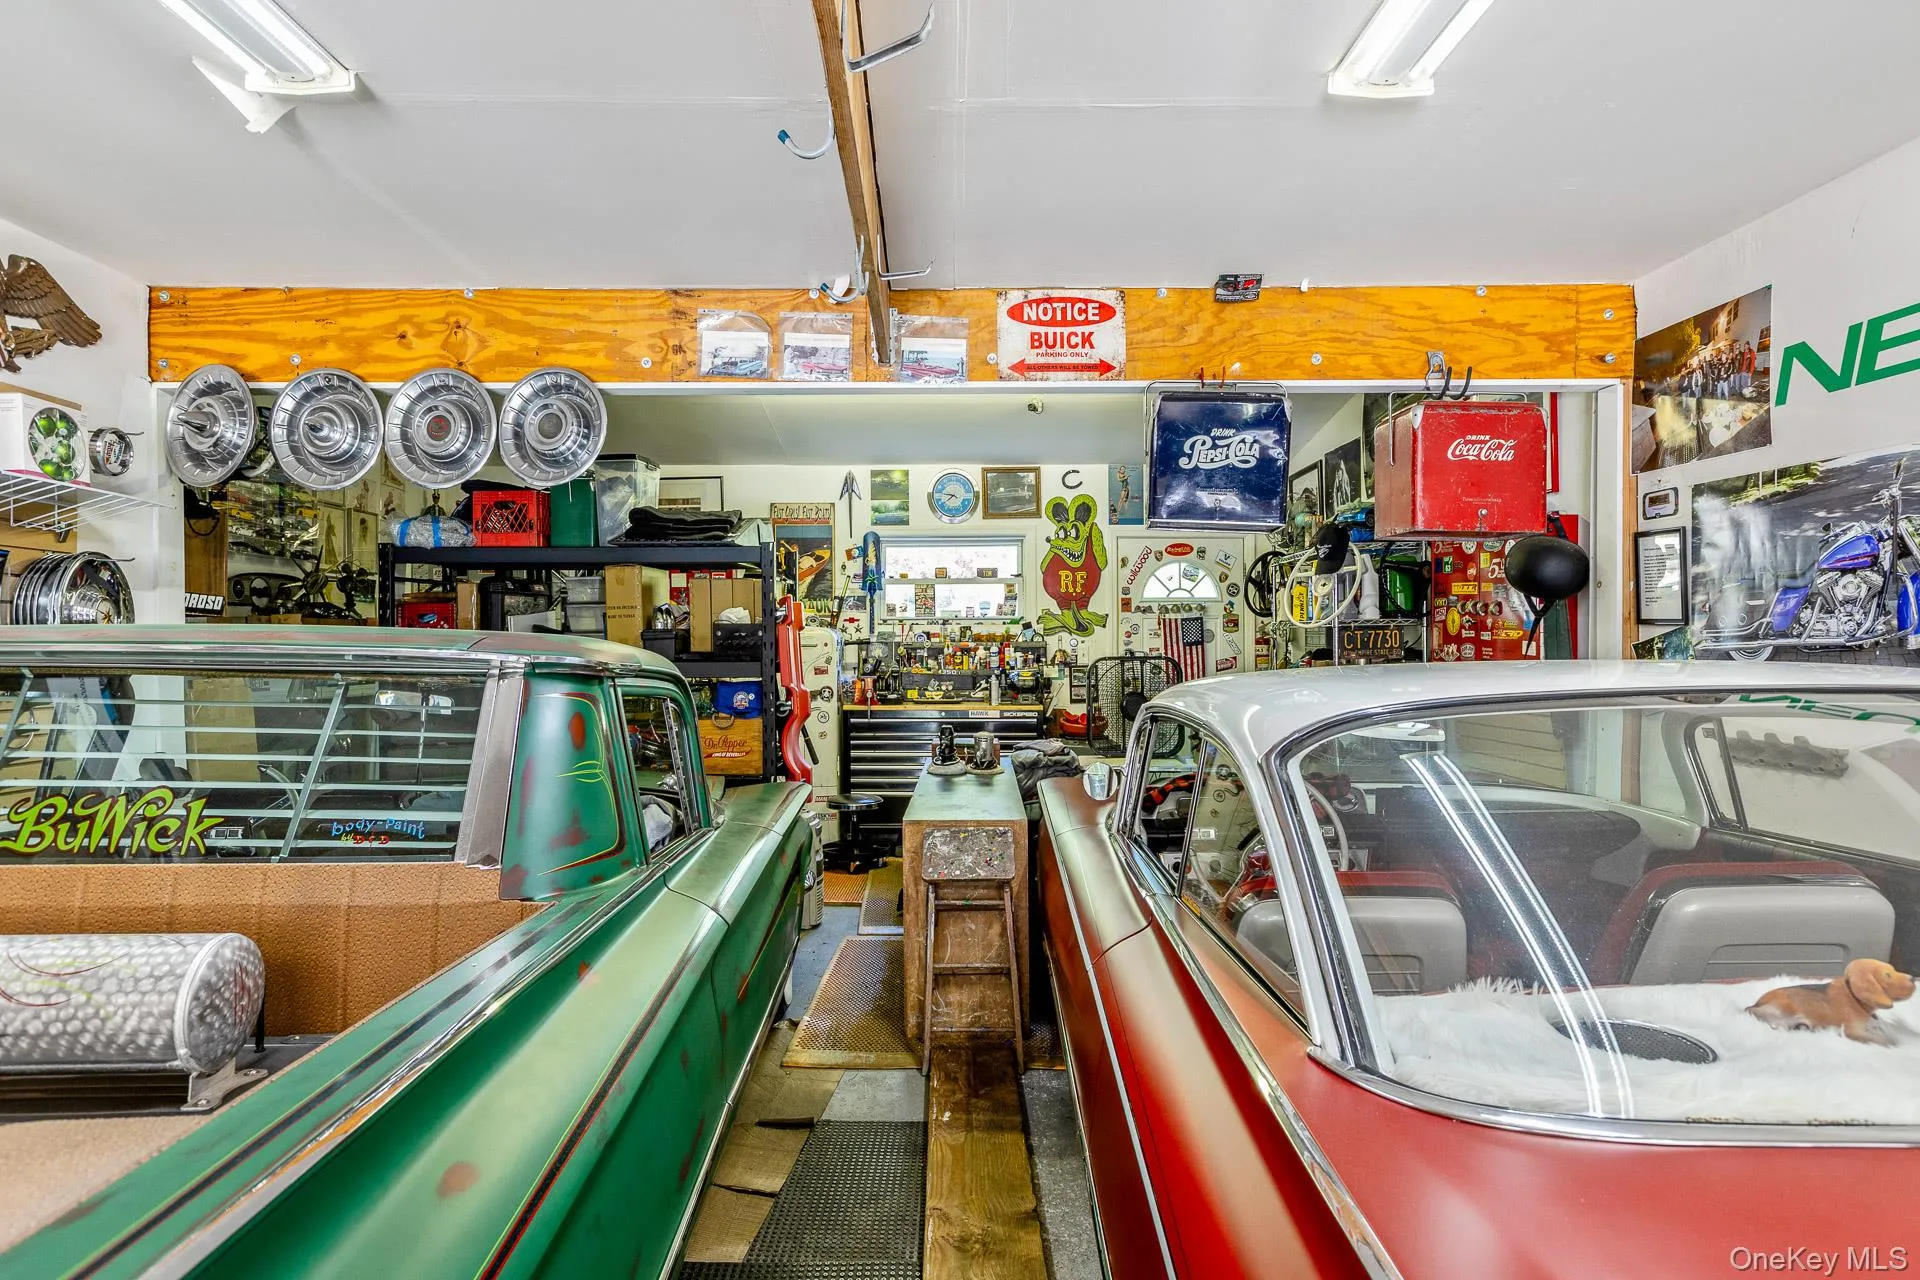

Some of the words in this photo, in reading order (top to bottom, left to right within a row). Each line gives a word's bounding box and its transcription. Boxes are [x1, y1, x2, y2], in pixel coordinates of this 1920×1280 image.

[1023, 302, 1100, 321] NOTICE
[1030, 331, 1095, 350] BUICK
[1211, 428, 1236, 437] DRINK
[1126, 545, 1153, 586] wilwood
[0, 785, 225, 858] BuWick
